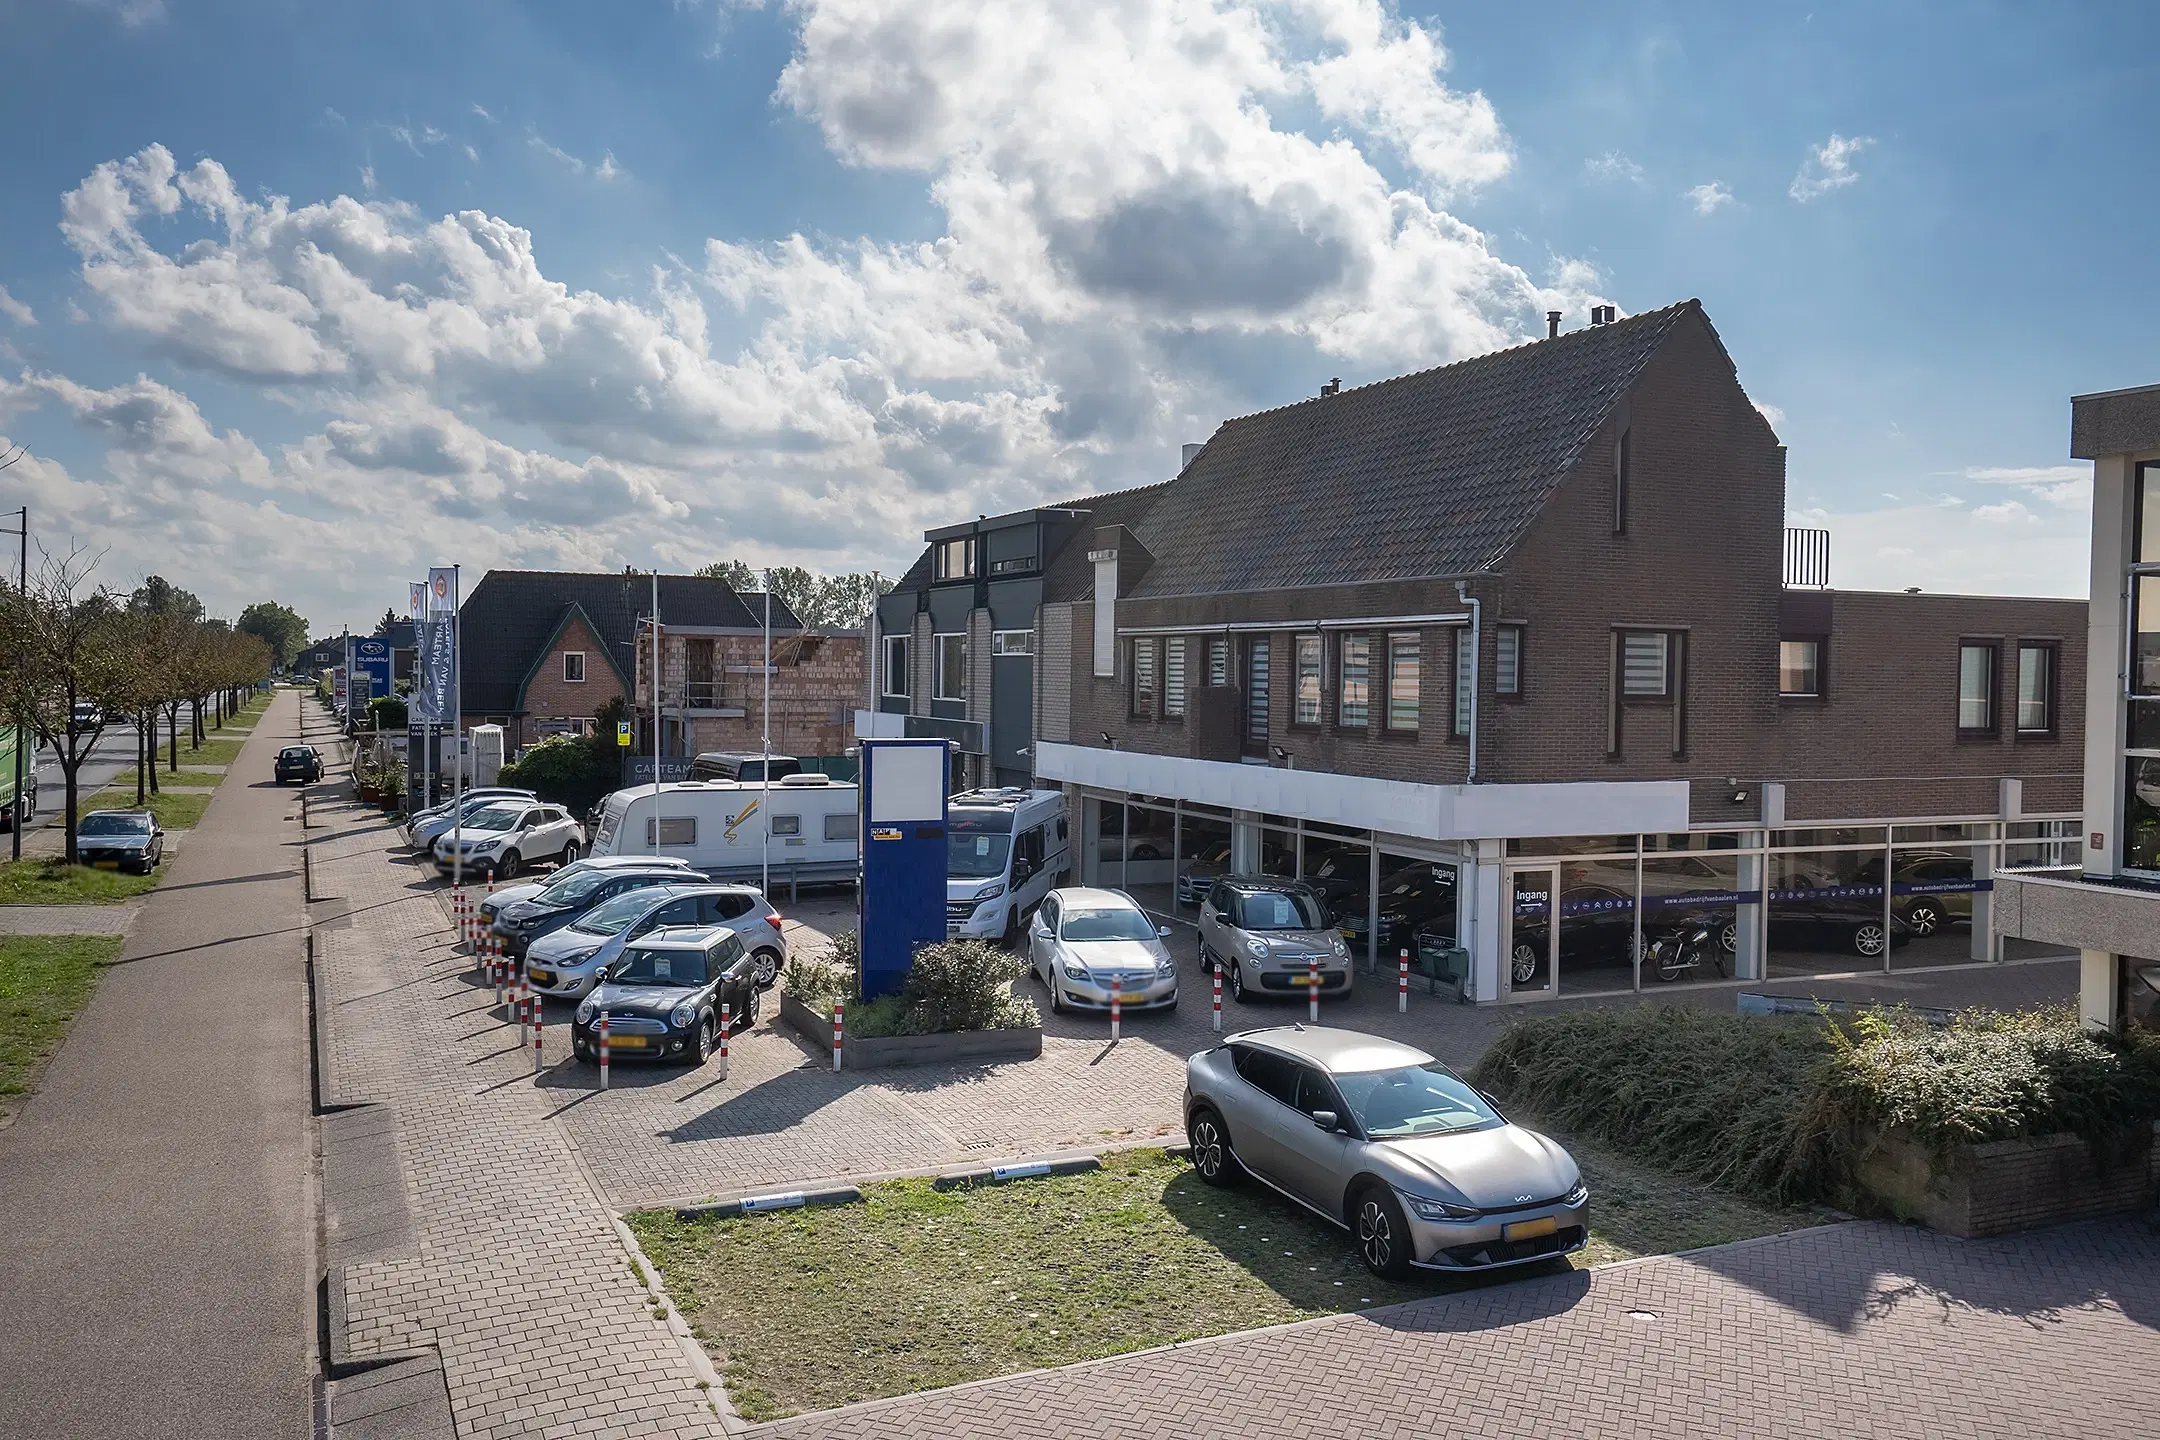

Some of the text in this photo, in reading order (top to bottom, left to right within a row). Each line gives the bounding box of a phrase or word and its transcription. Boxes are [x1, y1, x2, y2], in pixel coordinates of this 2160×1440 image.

[621, 725, 627, 733] P
[1431, 866, 1455, 881] Ingang
[1516, 890, 1548, 902] Ingang
